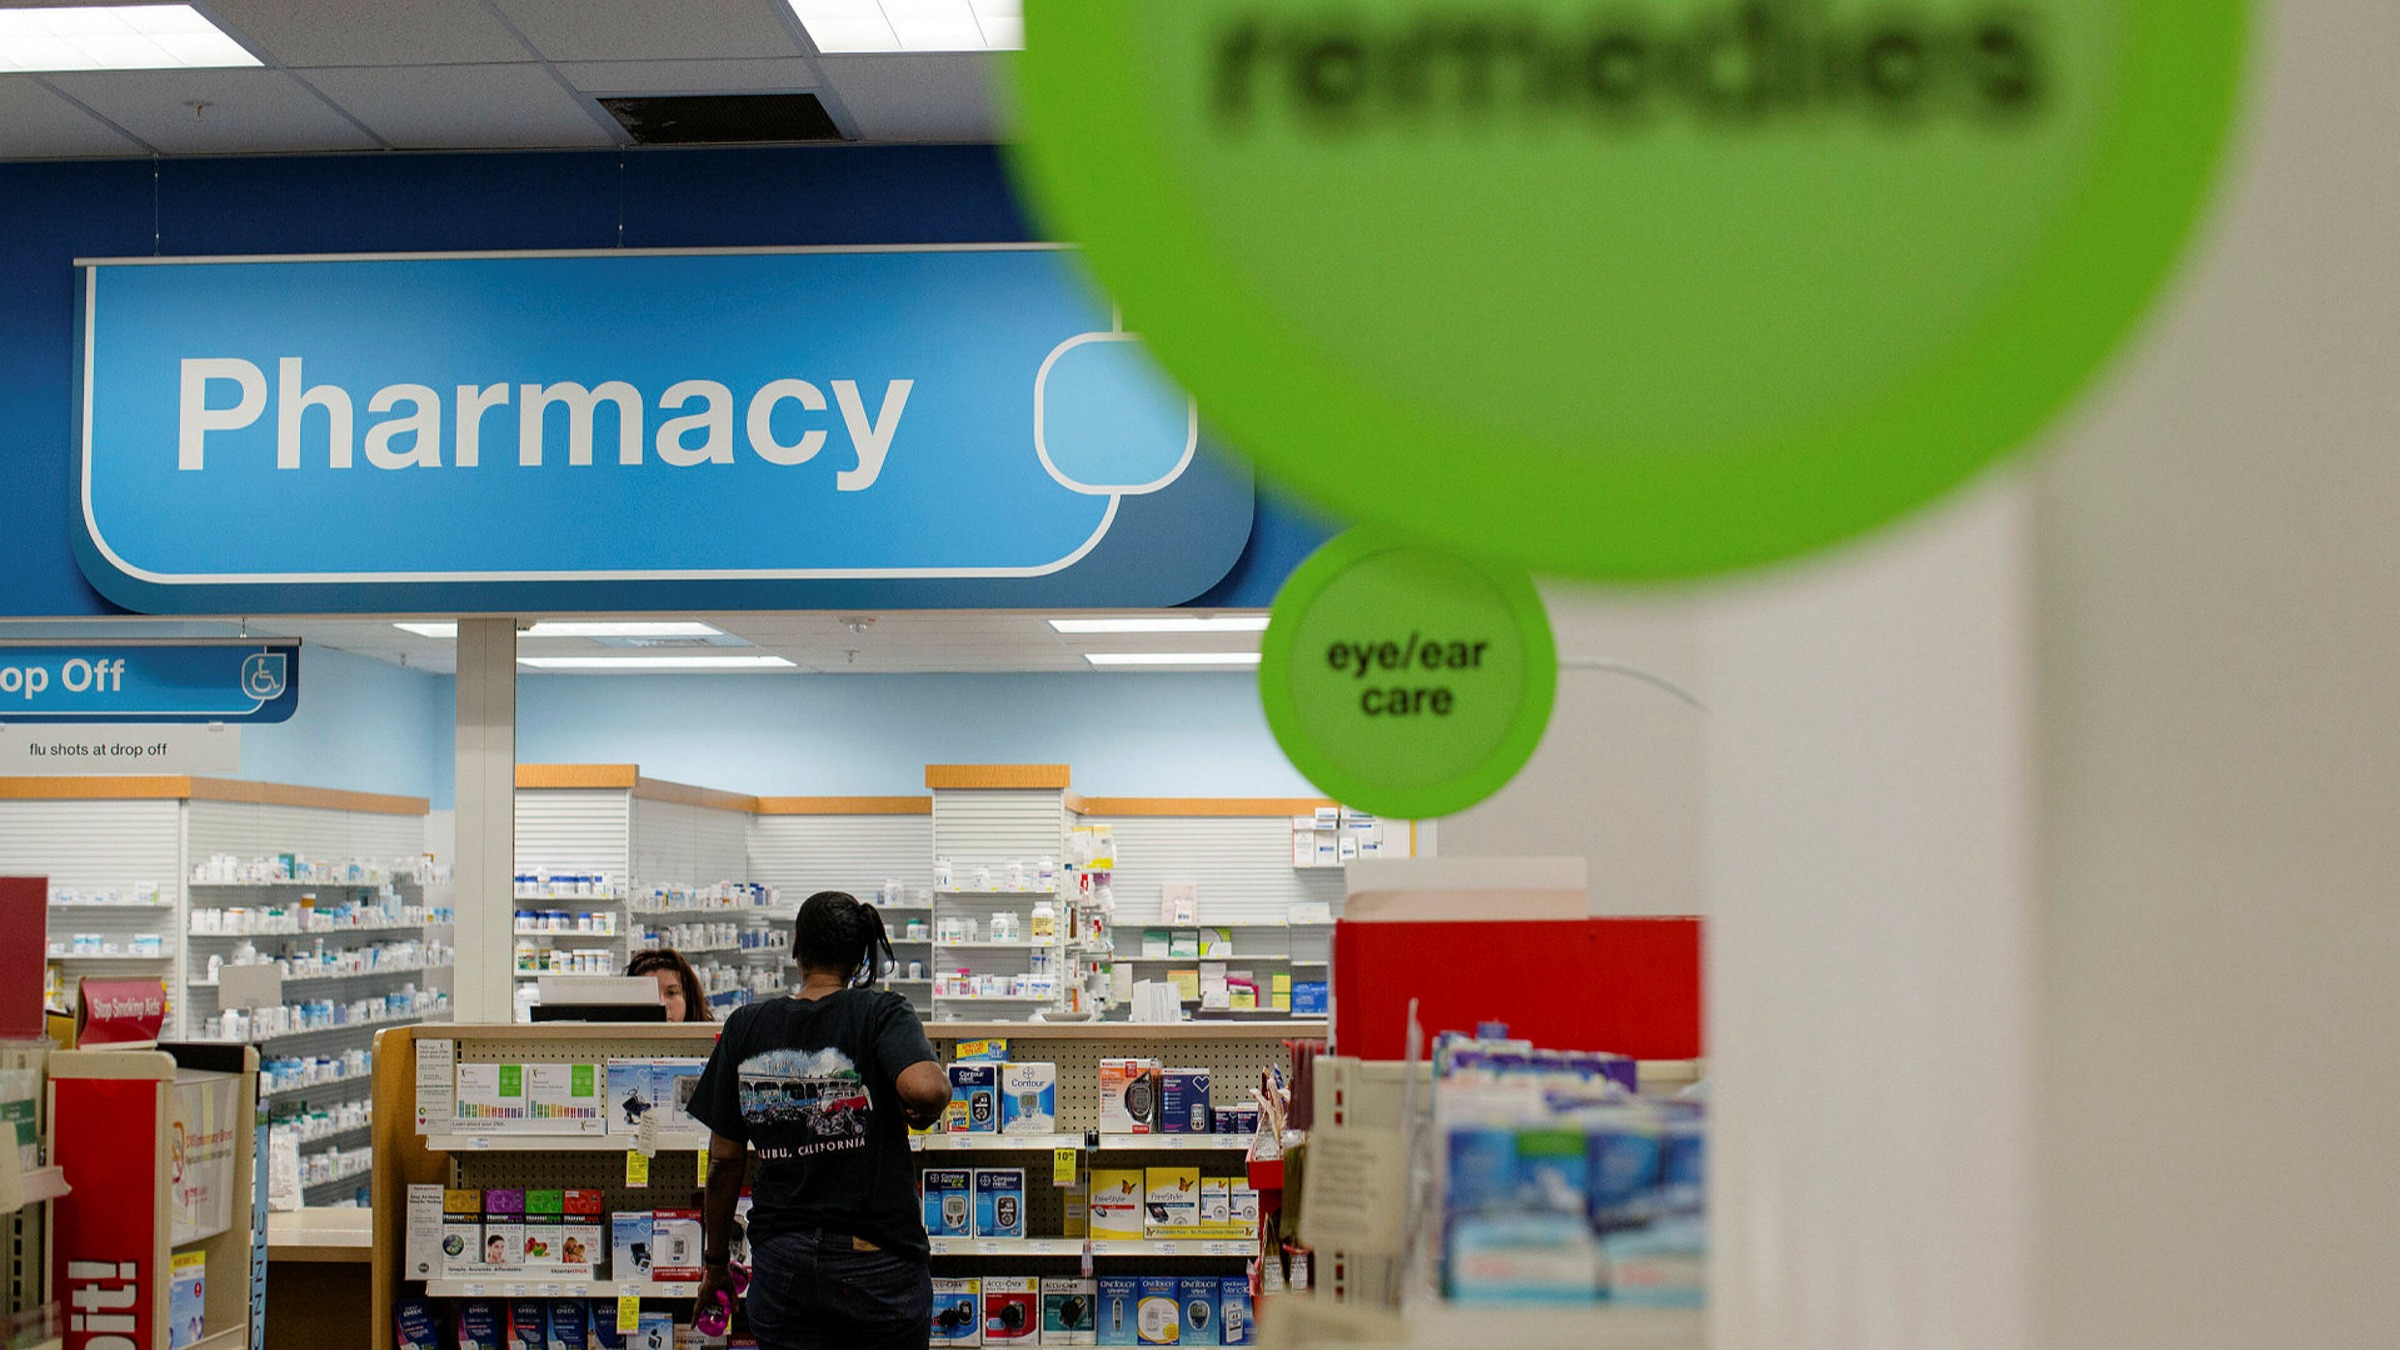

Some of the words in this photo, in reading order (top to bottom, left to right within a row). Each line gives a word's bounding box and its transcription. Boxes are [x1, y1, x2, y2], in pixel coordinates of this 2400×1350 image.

[1208, 0, 2046, 130] remedies
[178, 357, 915, 492] Pharmacy
[1326, 632, 1489, 678] eye/ear
[62, 658, 125, 692] Off
[1360, 686, 1454, 716] care
[30, 743, 46, 756] flu
[50, 743, 89, 756] shots
[93, 744, 106, 756] at
[110, 743, 143, 758] drop
[147, 743, 167, 756] off
[93, 997, 112, 1022] Stop
[112, 996, 144, 1022] Smoking
[144, 996, 160, 1016] Aids
[959, 1070, 985, 1078] Contour
[1011, 1079, 1046, 1088] Contour
[798, 1137, 866, 1157] CALIFORNIA
[1094, 1194, 1127, 1204] FreeStyle
[1151, 1192, 1184, 1202] FreeStyle
